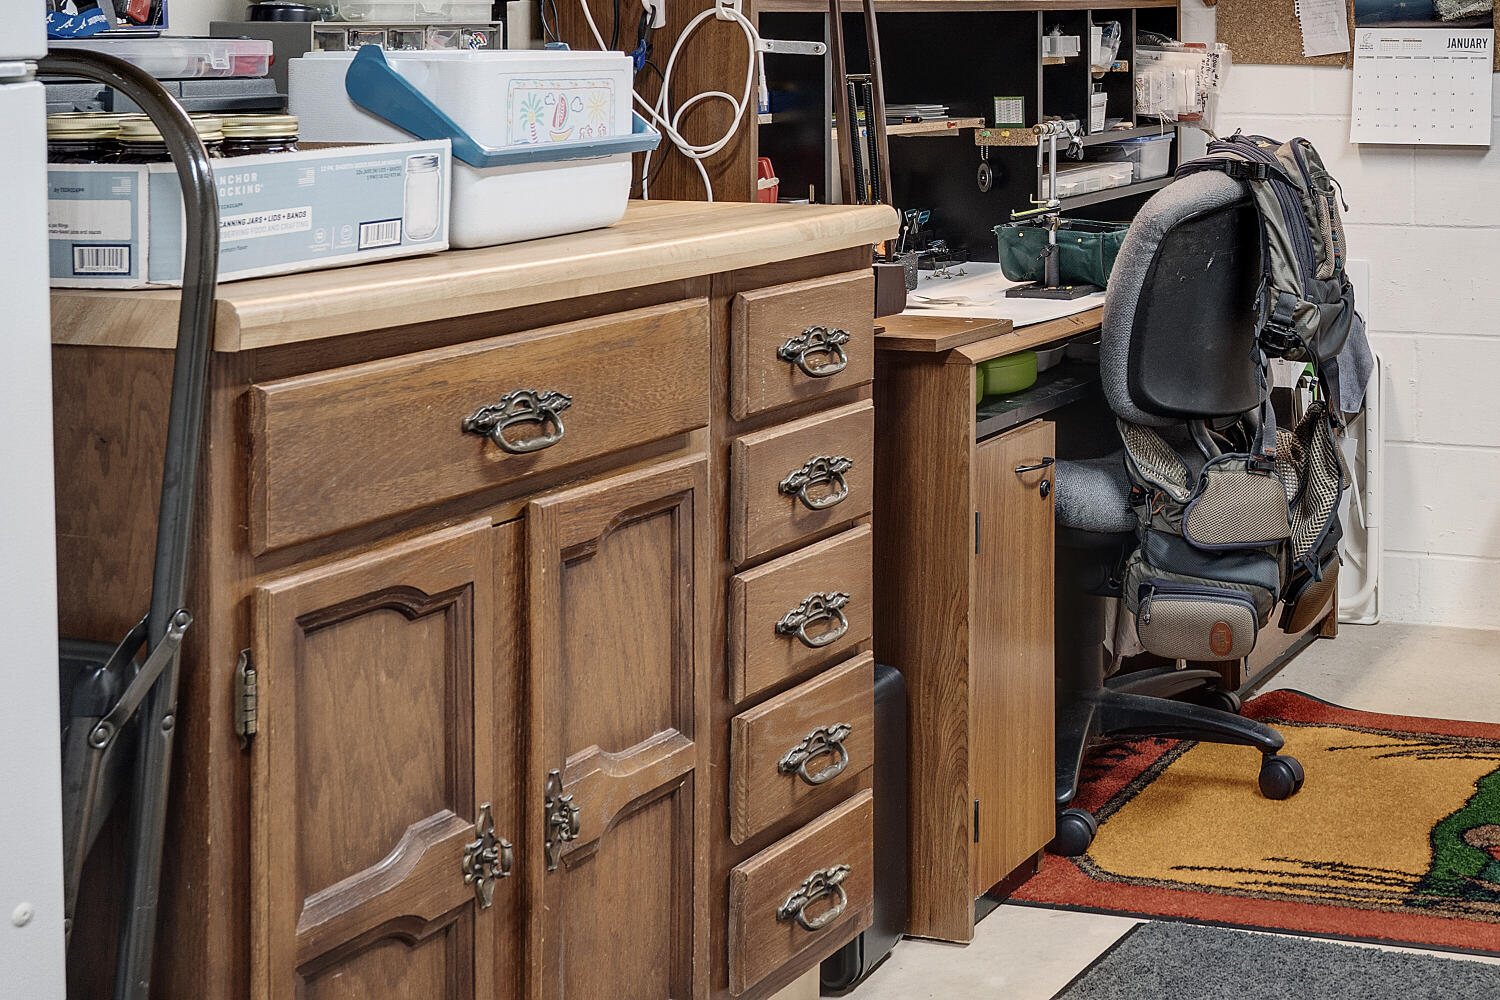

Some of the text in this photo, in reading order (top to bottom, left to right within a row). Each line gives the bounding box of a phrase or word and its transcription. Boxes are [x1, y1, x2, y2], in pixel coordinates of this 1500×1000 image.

[1447, 37, 1488, 49] JANUARY
[217, 172, 258, 185] NCHOR
[218, 184, 262, 197] OCKING
[247, 215, 263, 225] JARS
[268, 213, 281, 222] LIDS
[287, 210, 307, 219] BANDS
